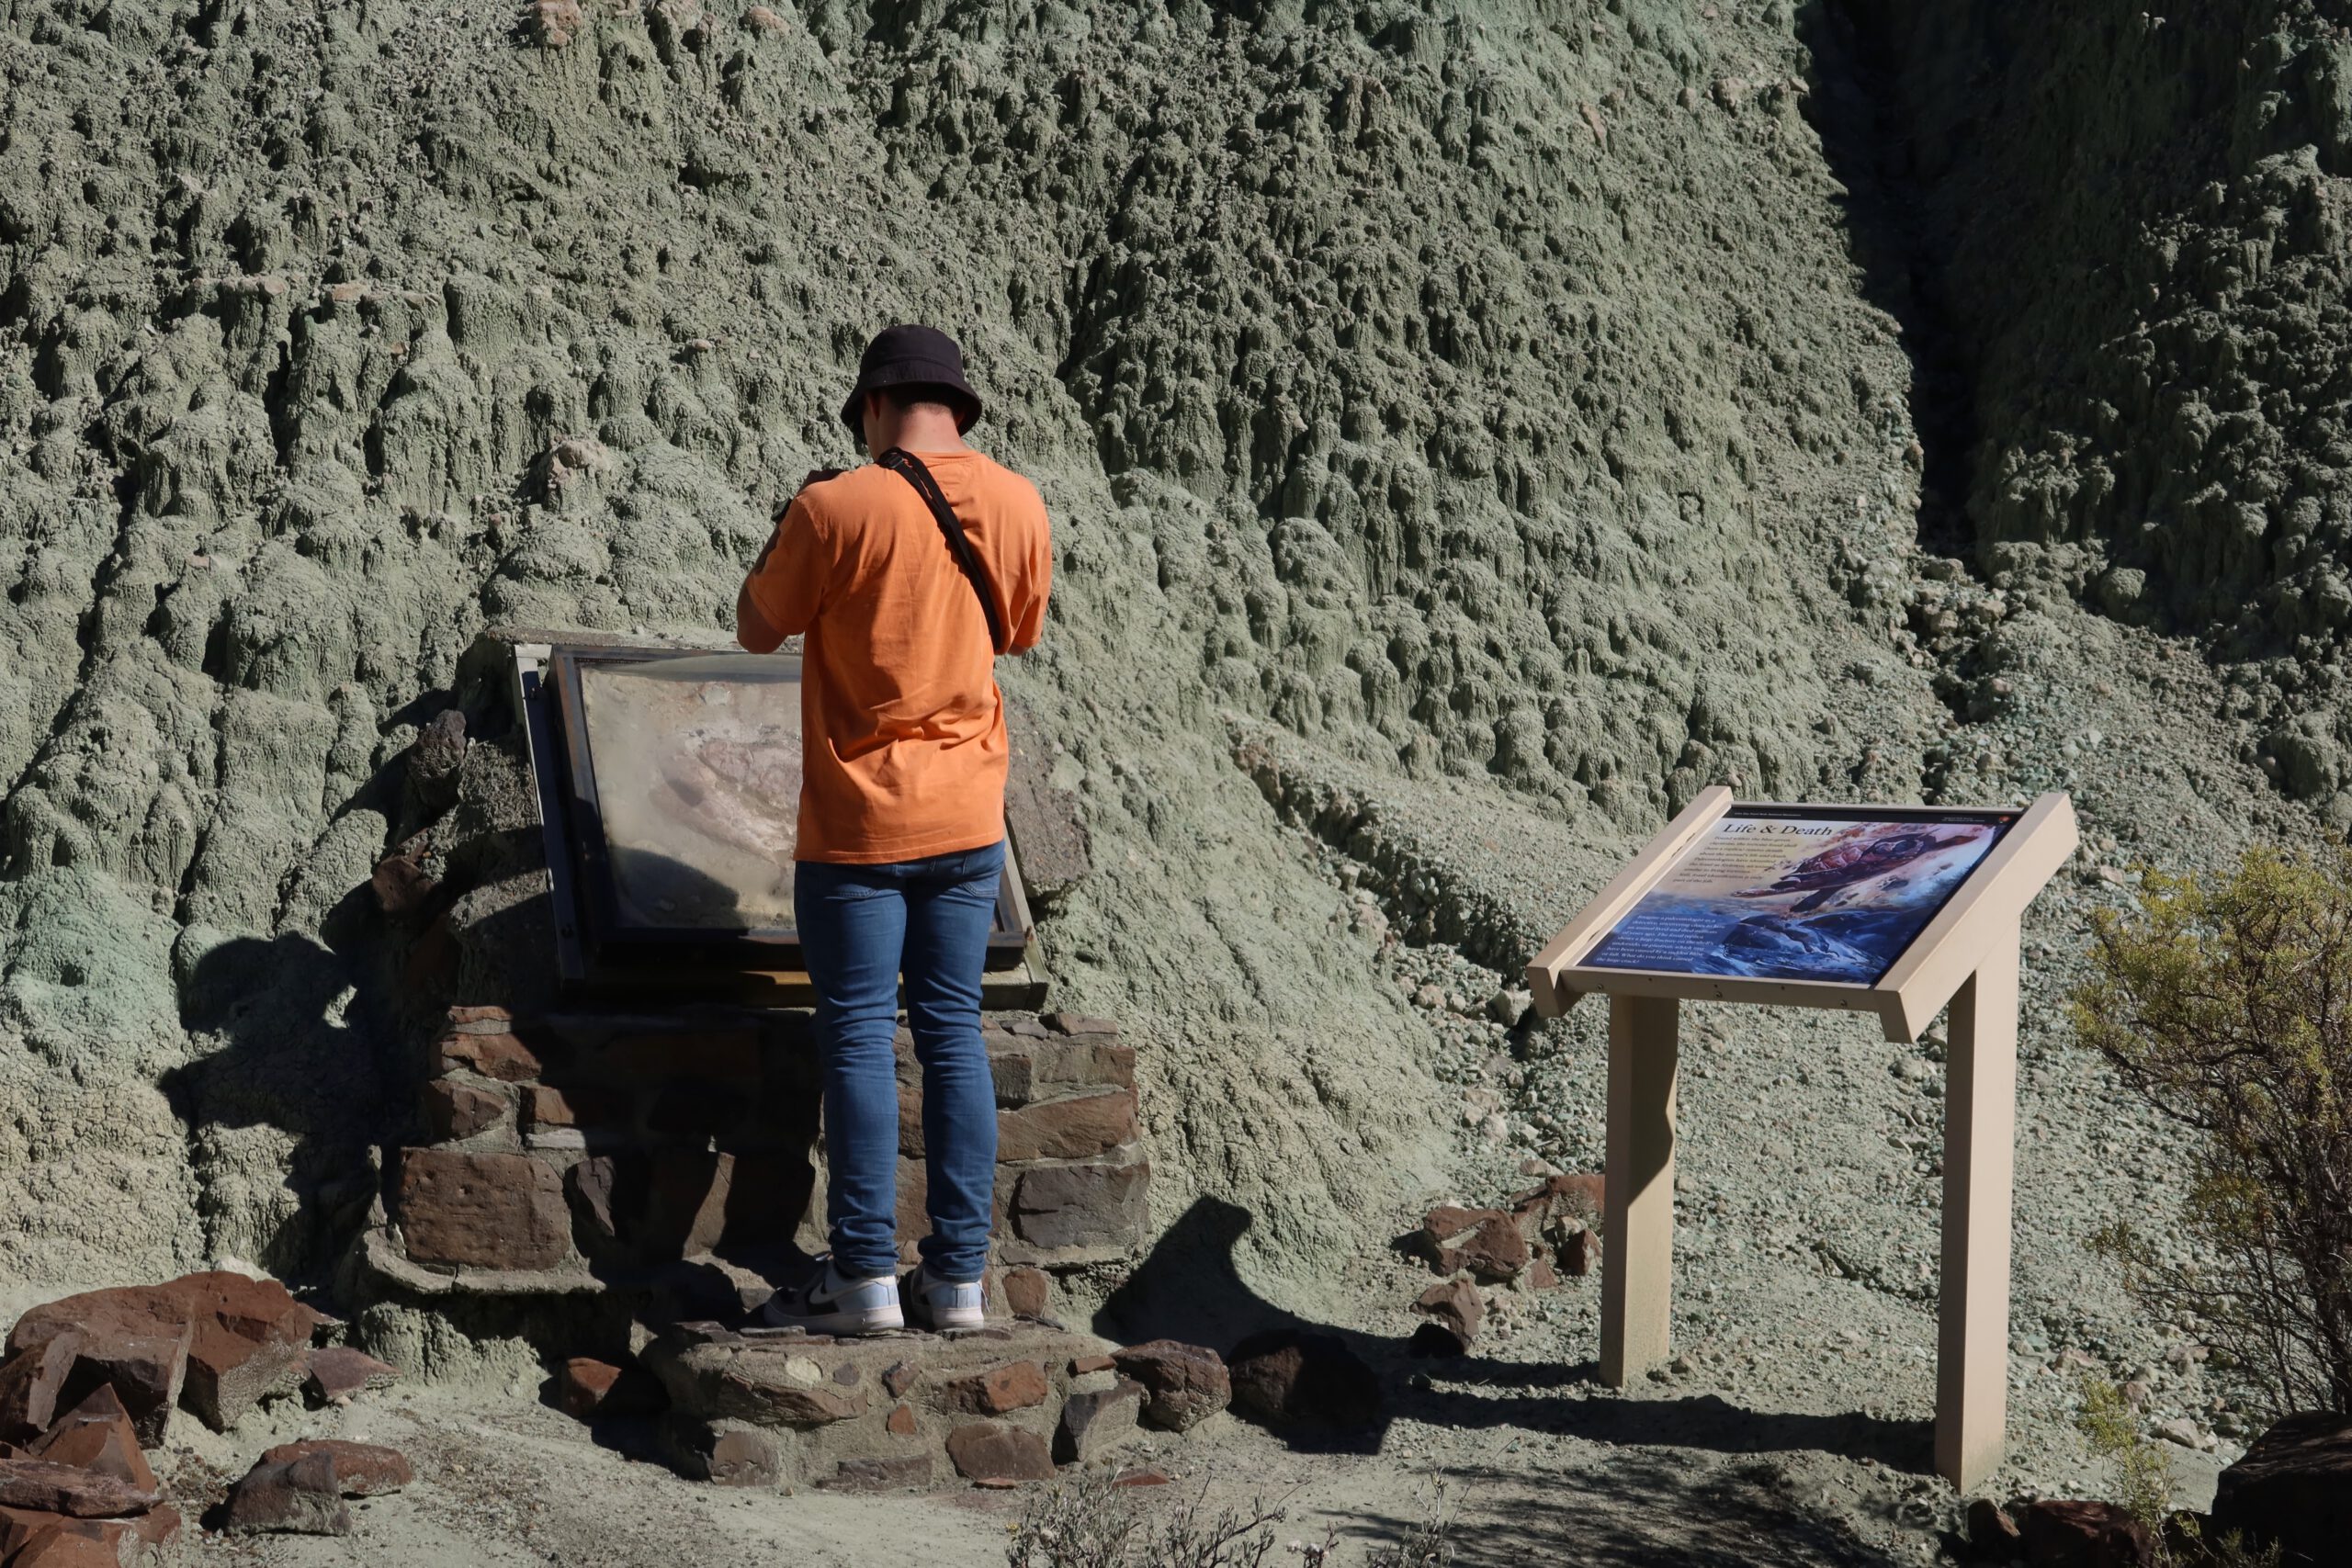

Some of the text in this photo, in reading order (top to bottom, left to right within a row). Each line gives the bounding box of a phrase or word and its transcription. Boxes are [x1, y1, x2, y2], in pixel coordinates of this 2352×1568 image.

[1723, 824, 1833, 836] Life & Death
